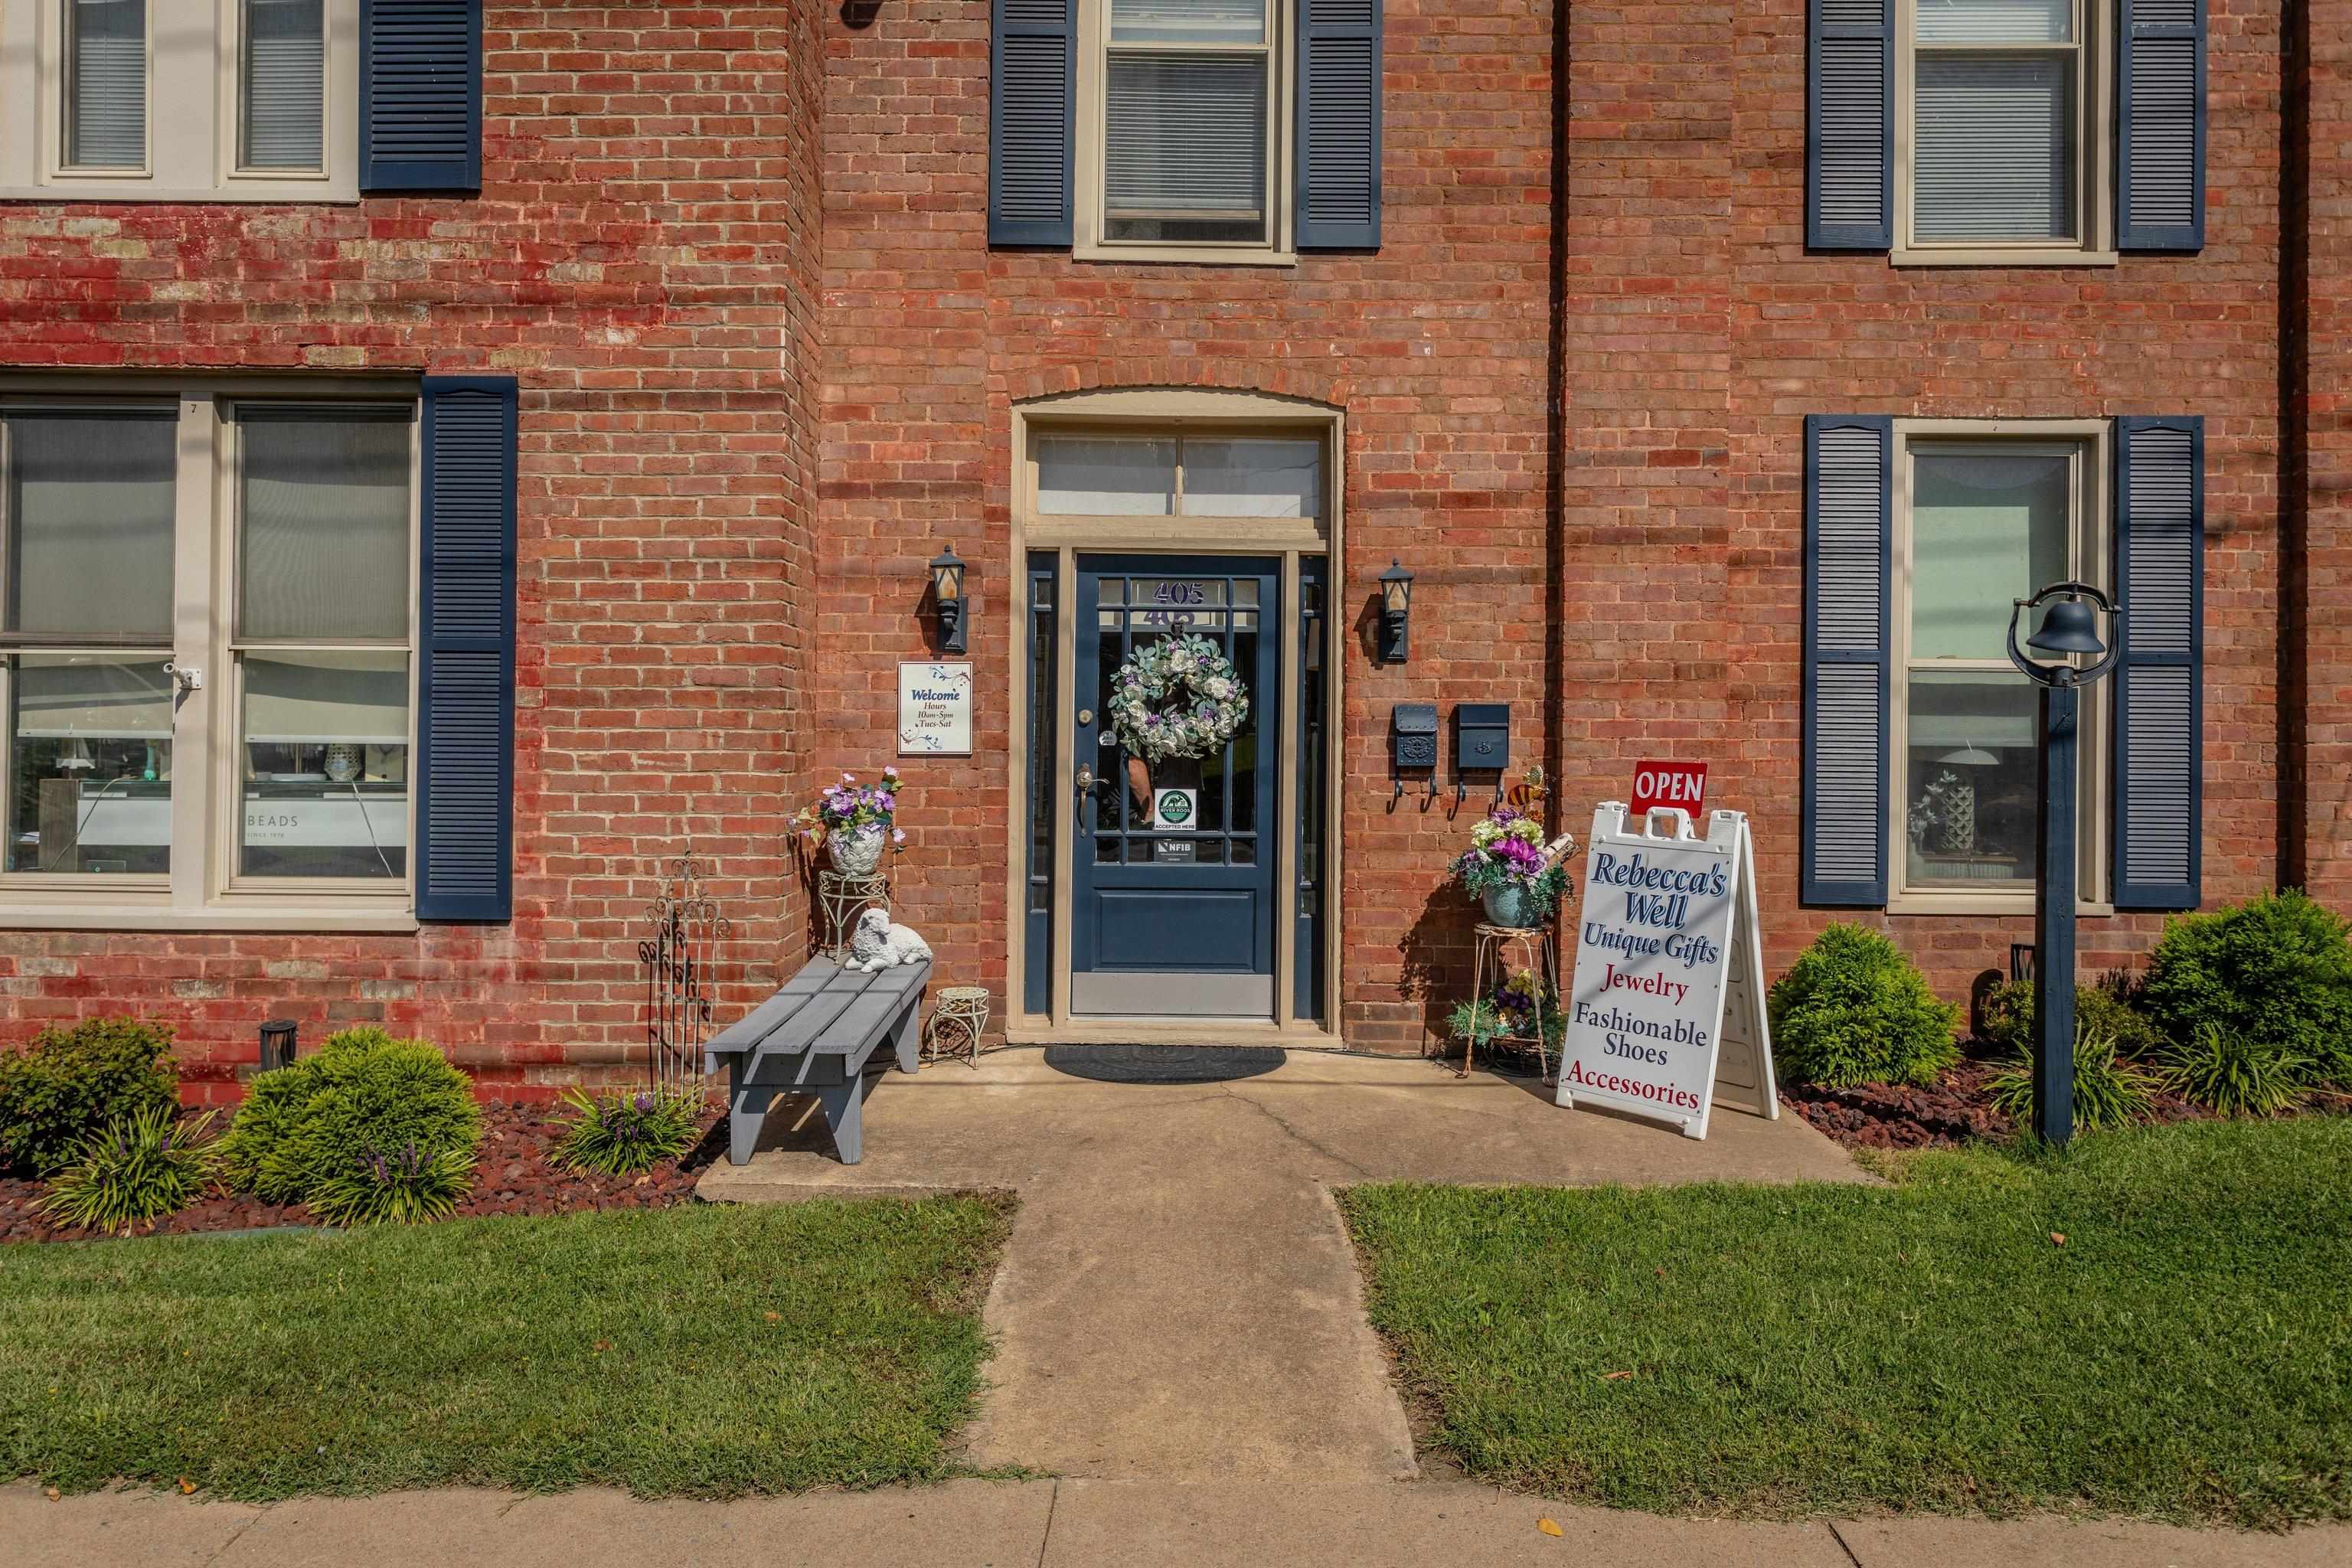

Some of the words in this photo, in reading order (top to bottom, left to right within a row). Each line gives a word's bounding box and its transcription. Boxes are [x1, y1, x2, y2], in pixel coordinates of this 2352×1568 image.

[1153, 582, 1204, 604] 405
[912, 688, 960, 701] Welcome
[1636, 772, 1704, 801] OPEN
[248, 815, 298, 827] BEADS
[1590, 851, 1727, 897] Rebecca's
[1625, 891, 1689, 930] Well
[1584, 922, 1661, 960] Unique
[1665, 933, 1719, 969] Gifts
[1599, 963, 1690, 1006] Jewelry
[1573, 1001, 1707, 1047] Fashionable
[1603, 1033, 1668, 1065] Shoes
[1565, 1060, 1699, 1109] Accessories
